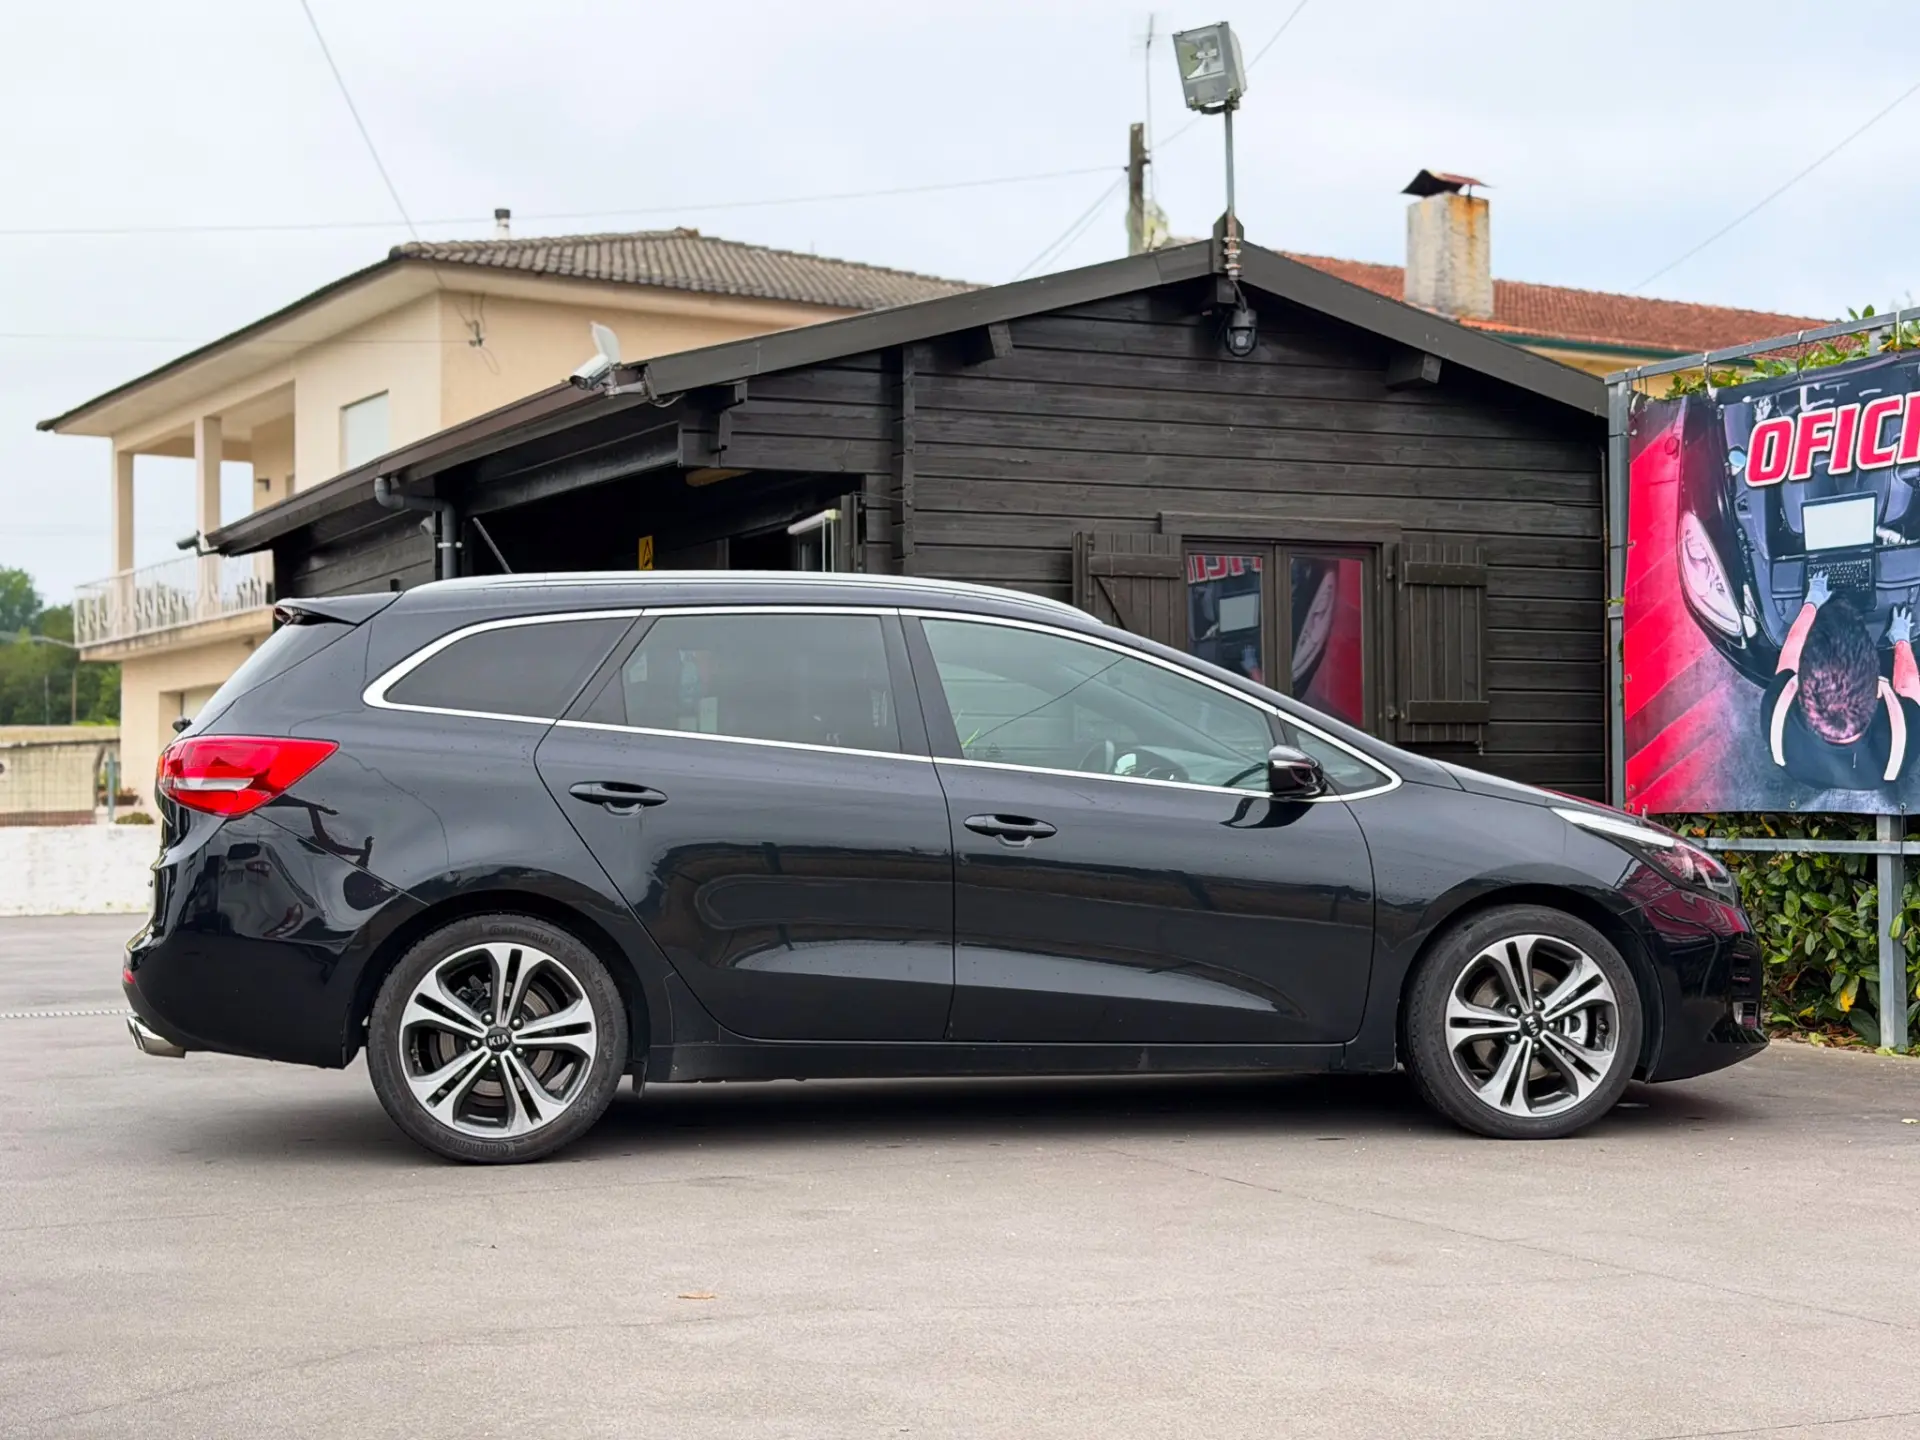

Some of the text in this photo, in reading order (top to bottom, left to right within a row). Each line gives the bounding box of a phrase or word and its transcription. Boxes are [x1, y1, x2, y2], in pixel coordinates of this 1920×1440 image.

[1745, 391, 1920, 487] OFICI
[1525, 1015, 1539, 1036] KIA
[488, 1034, 510, 1047] KIA
